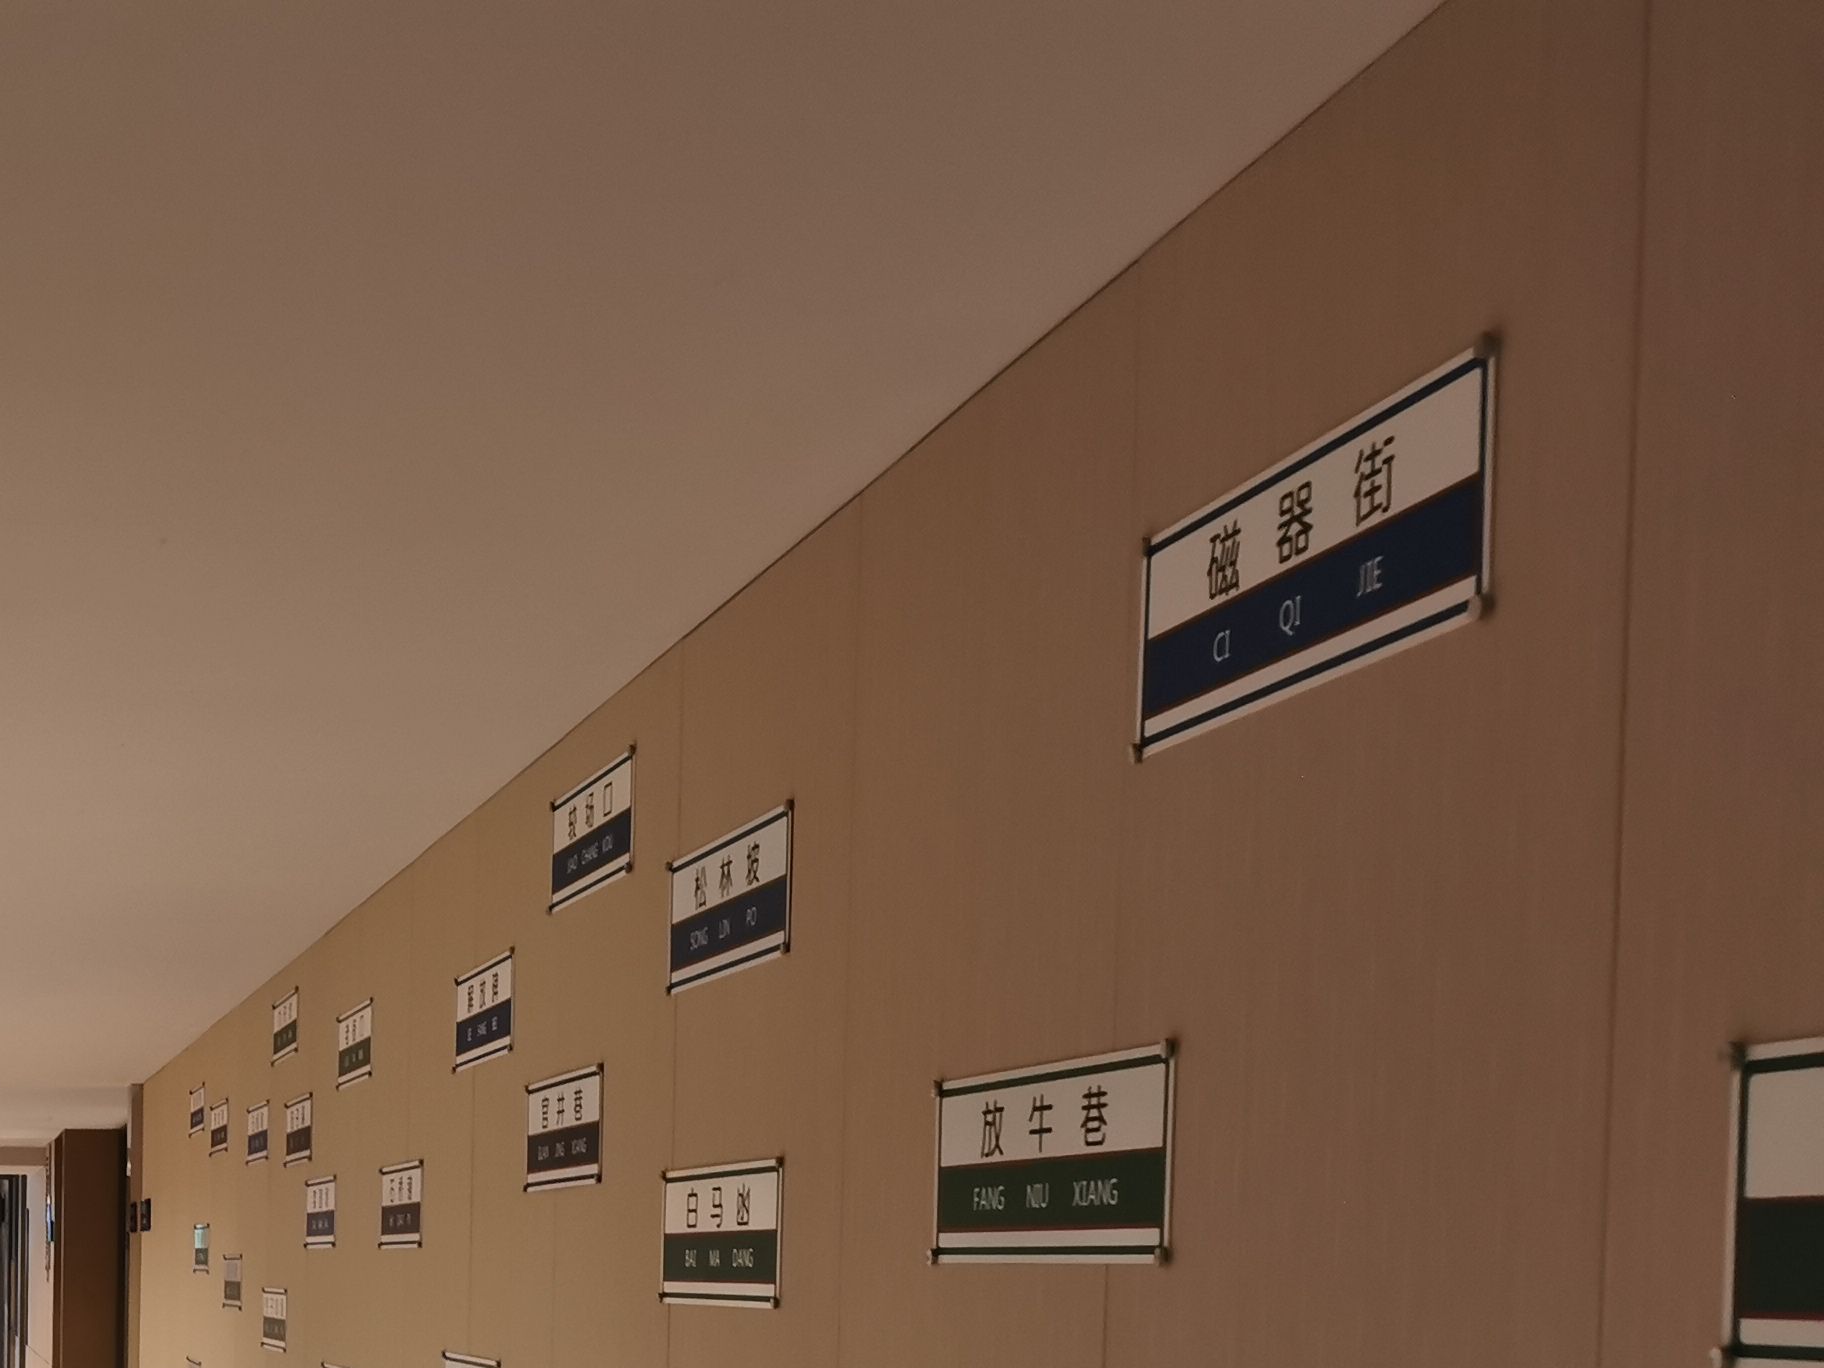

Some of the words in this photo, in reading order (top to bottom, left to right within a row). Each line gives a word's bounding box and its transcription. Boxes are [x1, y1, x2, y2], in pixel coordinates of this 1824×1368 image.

[1206, 435, 1396, 600] 磁器街
[1213, 629, 1232, 662] CI
[1278, 595, 1302, 638] QI
[1356, 555, 1385, 598] JIE
[694, 841, 760, 910] 松林坡
[690, 926, 709, 950] SONG
[718, 919, 730, 939] LIN
[745, 906, 757, 926] PO
[980, 1085, 1109, 1158] 放牛巷
[686, 1183, 751, 1229] 白马凼
[973, 1185, 1006, 1212] FANG
[1026, 1183, 1050, 1209] NIU
[1072, 1178, 1119, 1208] XIANG
[684, 1249, 697, 1268] BAI
[709, 1249, 720, 1268] MA
[732, 1248, 754, 1268] DANG
